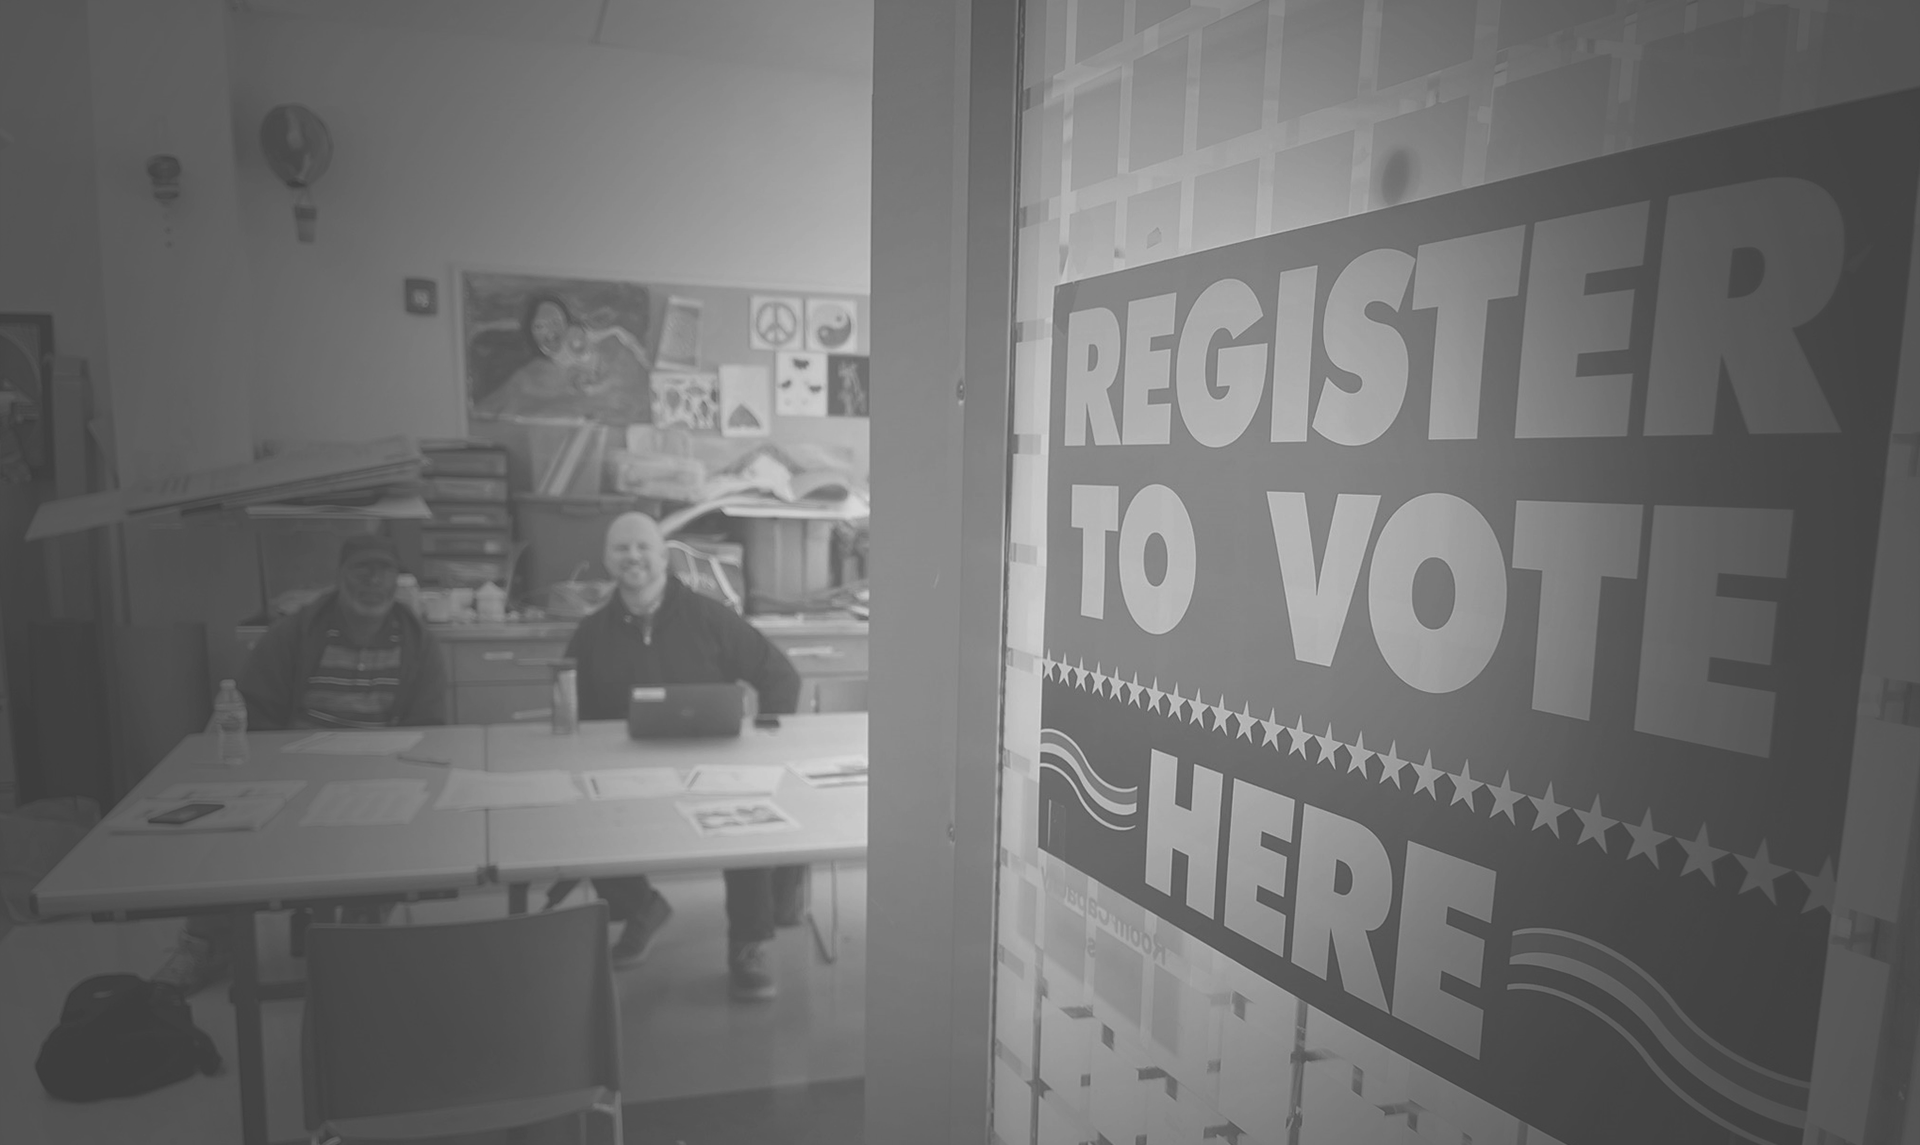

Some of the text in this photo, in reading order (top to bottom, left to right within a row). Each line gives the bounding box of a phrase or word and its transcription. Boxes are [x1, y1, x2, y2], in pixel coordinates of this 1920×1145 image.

[1064, 176, 1846, 447] REGISTER
[1071, 484, 1795, 759] TO VOTE
[1145, 748, 1498, 1061] HERE
